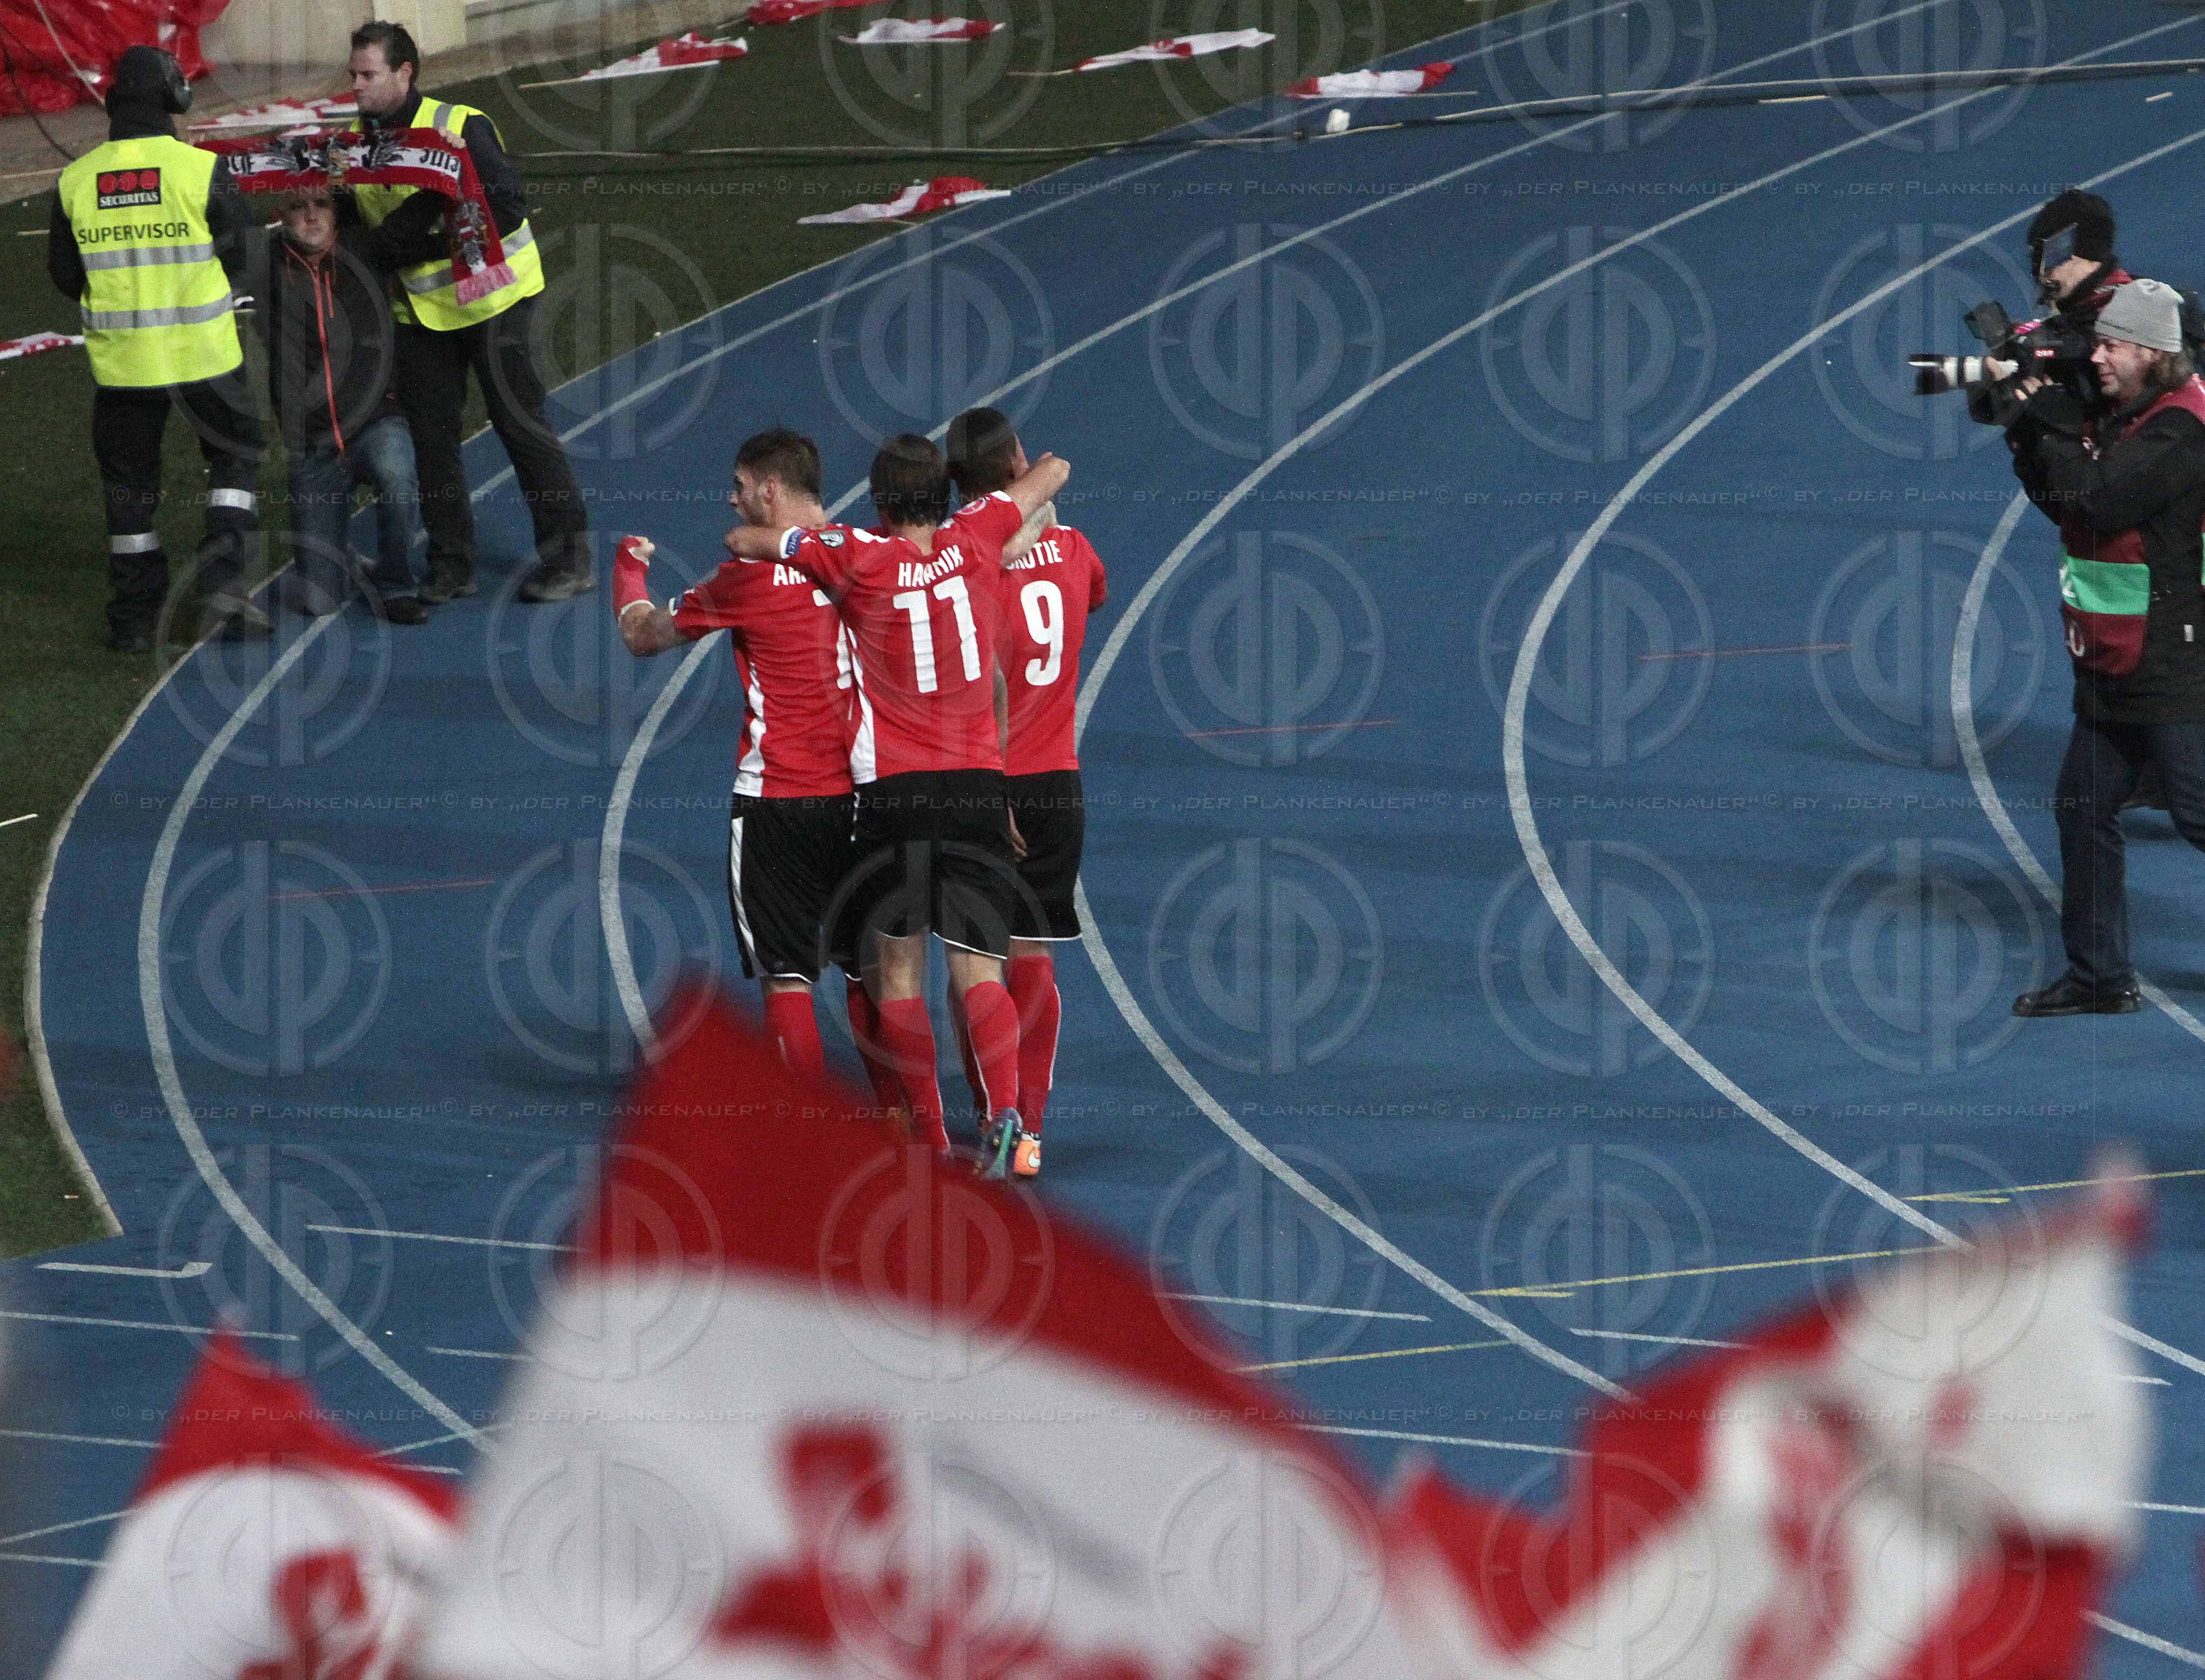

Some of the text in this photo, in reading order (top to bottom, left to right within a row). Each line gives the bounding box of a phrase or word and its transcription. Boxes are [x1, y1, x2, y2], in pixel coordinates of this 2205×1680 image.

[99, 192, 159, 208] SECURITAS
[77, 222, 190, 244] SUPERVISOR
[773, 564, 807, 586] AR
[893, 575, 981, 693] 11
[1020, 580, 1064, 686] 9
